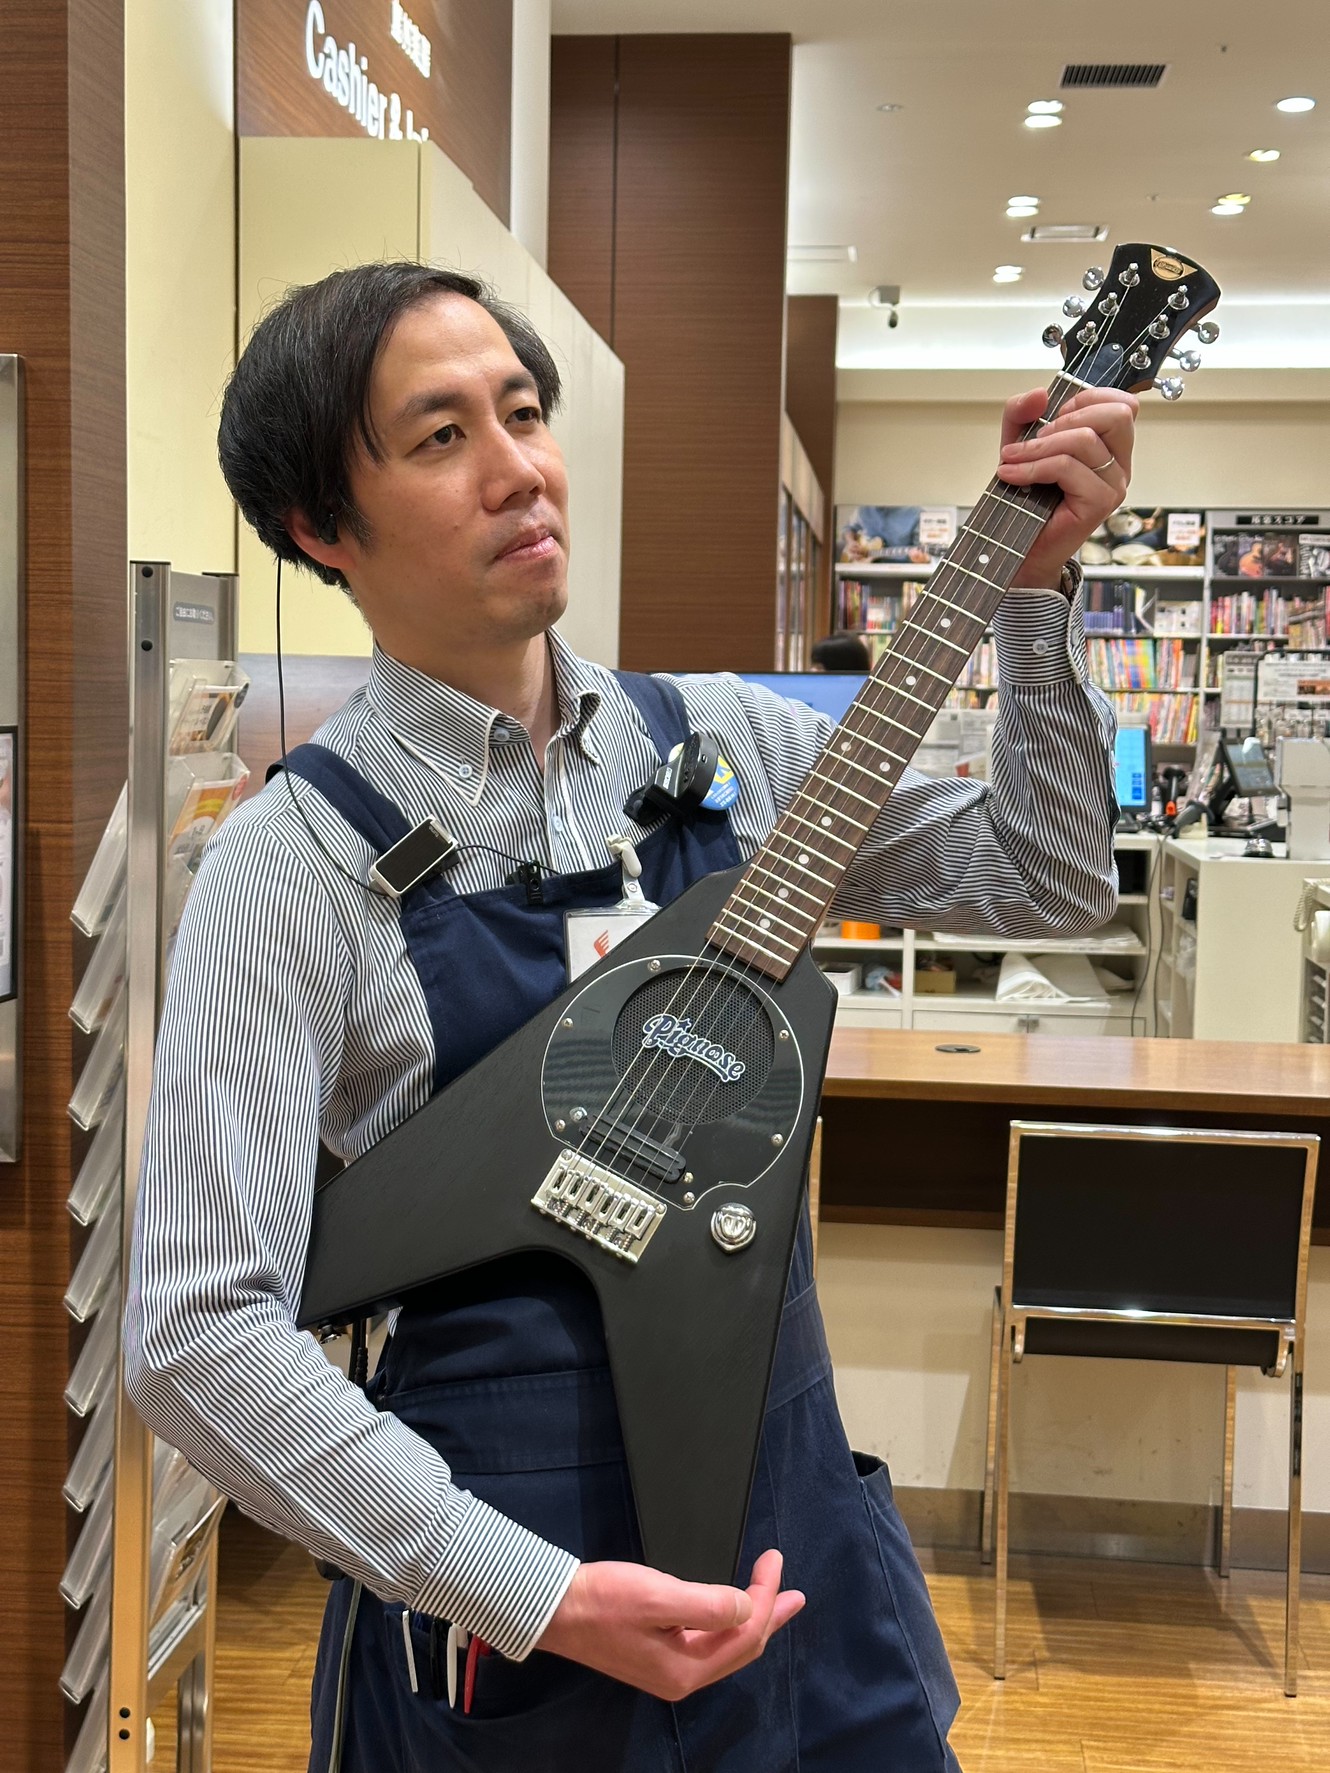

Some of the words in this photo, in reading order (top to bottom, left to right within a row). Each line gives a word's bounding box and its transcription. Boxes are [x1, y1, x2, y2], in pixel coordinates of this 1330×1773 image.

[305, 0, 388, 140] Cashier
[388, 92, 404, 141] &
[642, 1013, 746, 1082] Pignose
